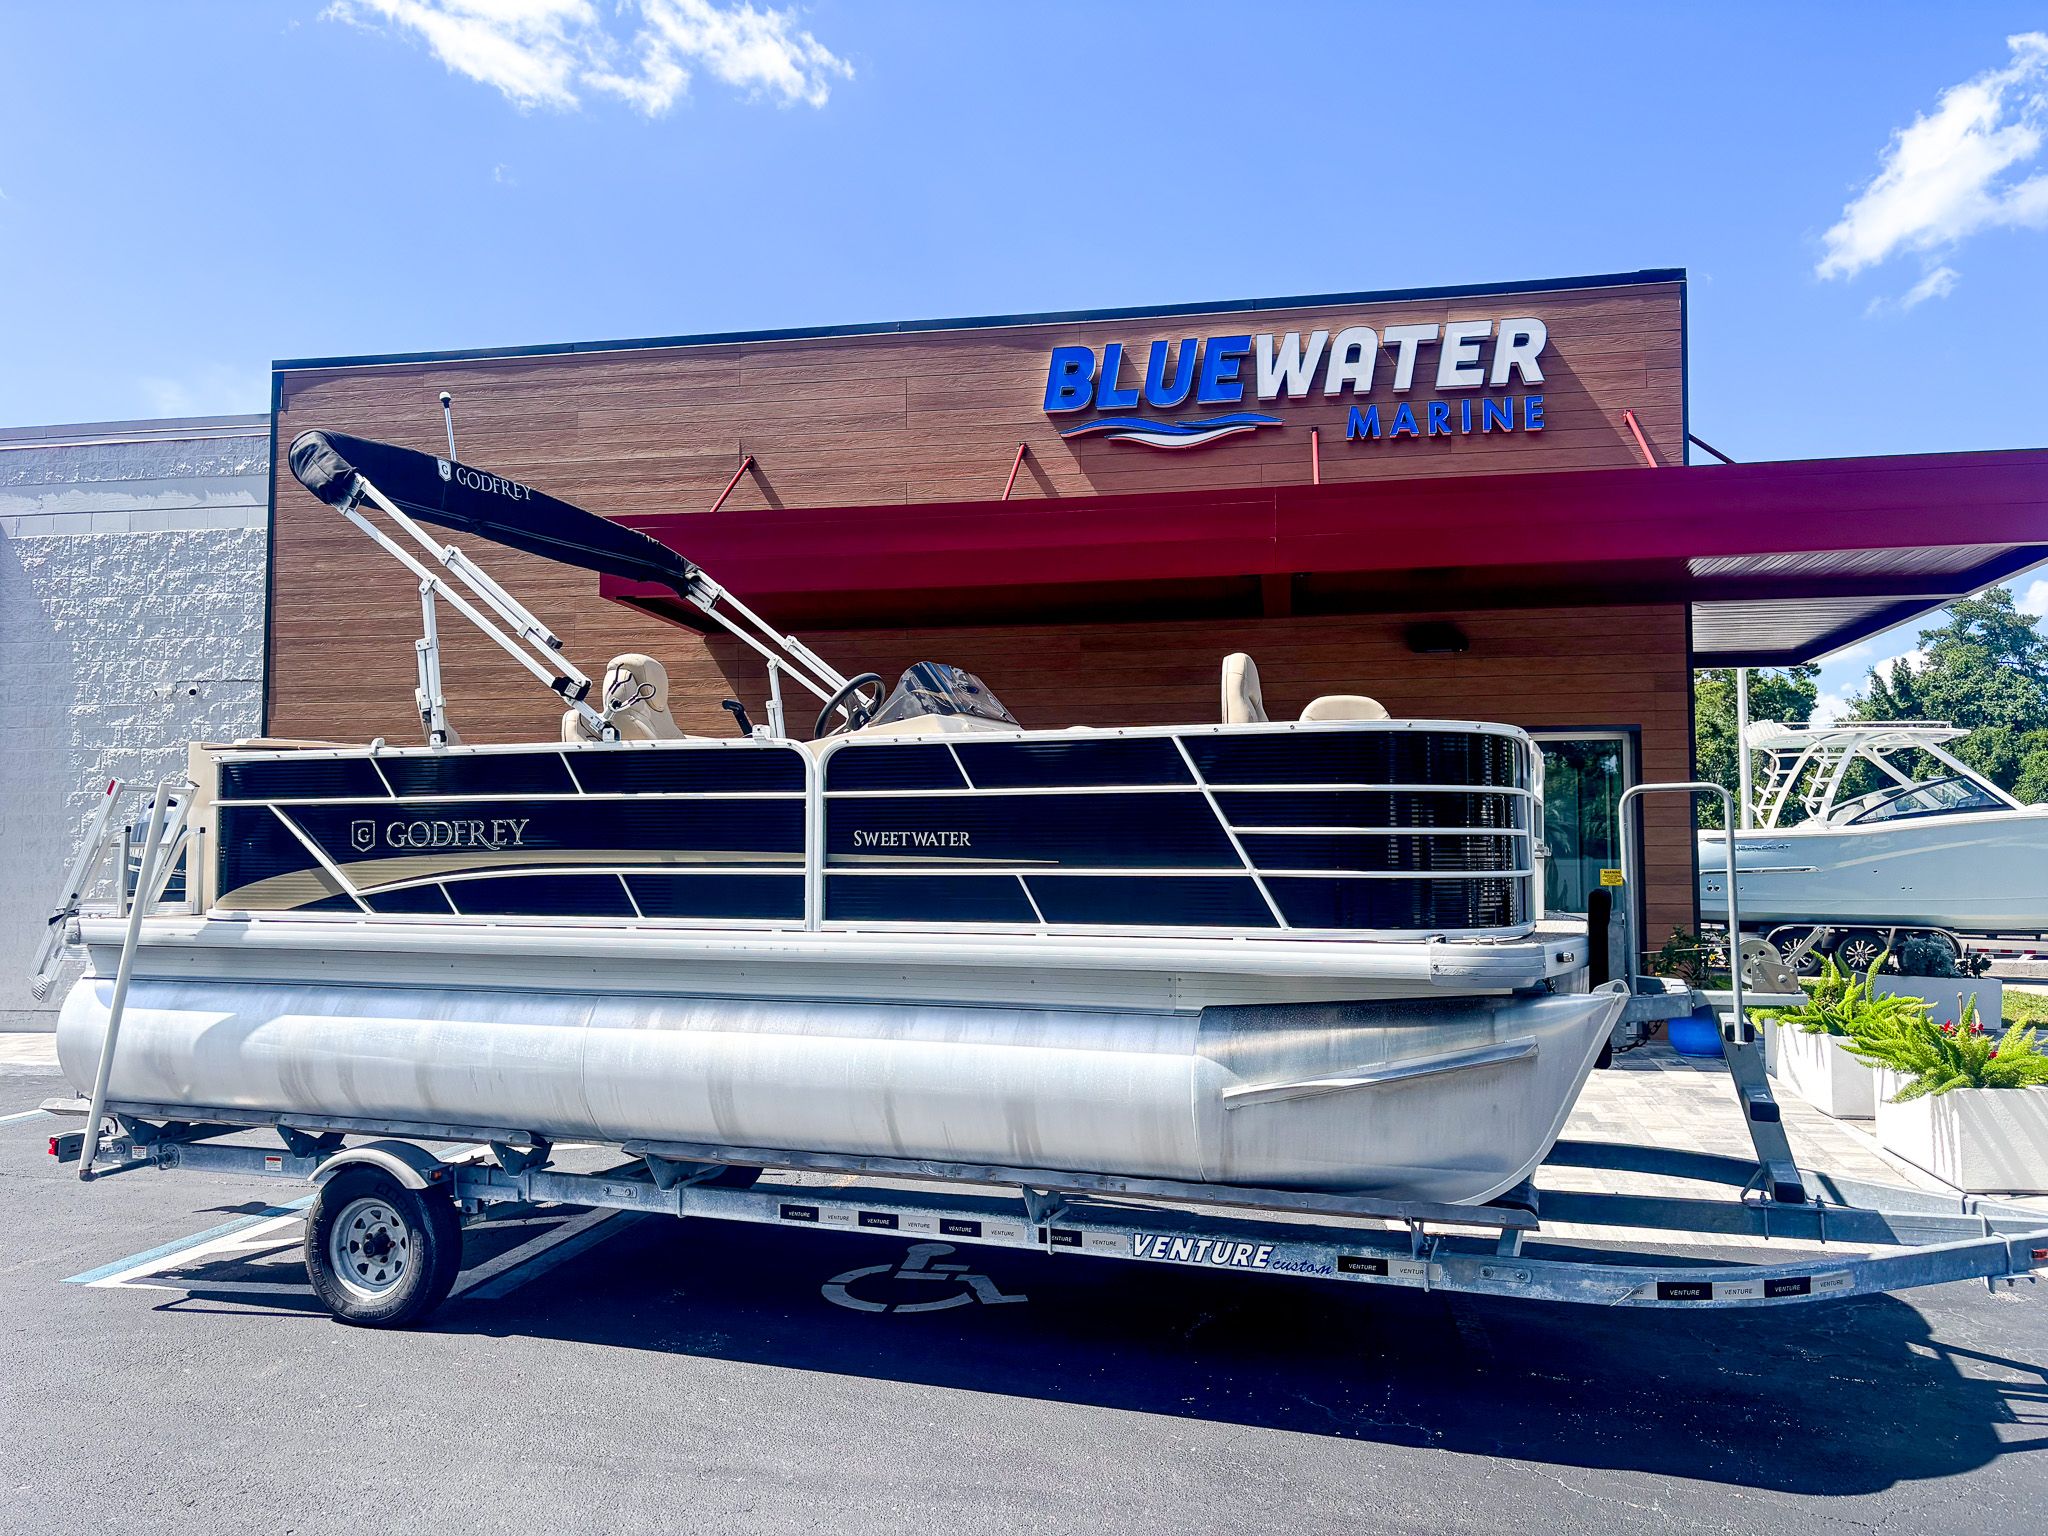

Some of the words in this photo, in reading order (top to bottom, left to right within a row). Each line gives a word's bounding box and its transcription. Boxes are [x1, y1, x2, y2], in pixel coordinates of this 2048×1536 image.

[1345, 395, 1546, 441] MARINE
[456, 467, 531, 501] GODFREY
[357, 827, 370, 843] G
[386, 818, 530, 851] GODFREY
[1092, 1239, 1117, 1247] VENTURE
[1133, 1233, 1275, 1269] VENTURE
[1272, 1259, 1333, 1275] custom
[1348, 1263, 1377, 1271] VENTURE
[1399, 1268, 1424, 1276] VENTUR
[1775, 1284, 1801, 1293] VENTURE
[1820, 1279, 1845, 1288] VENTURE
